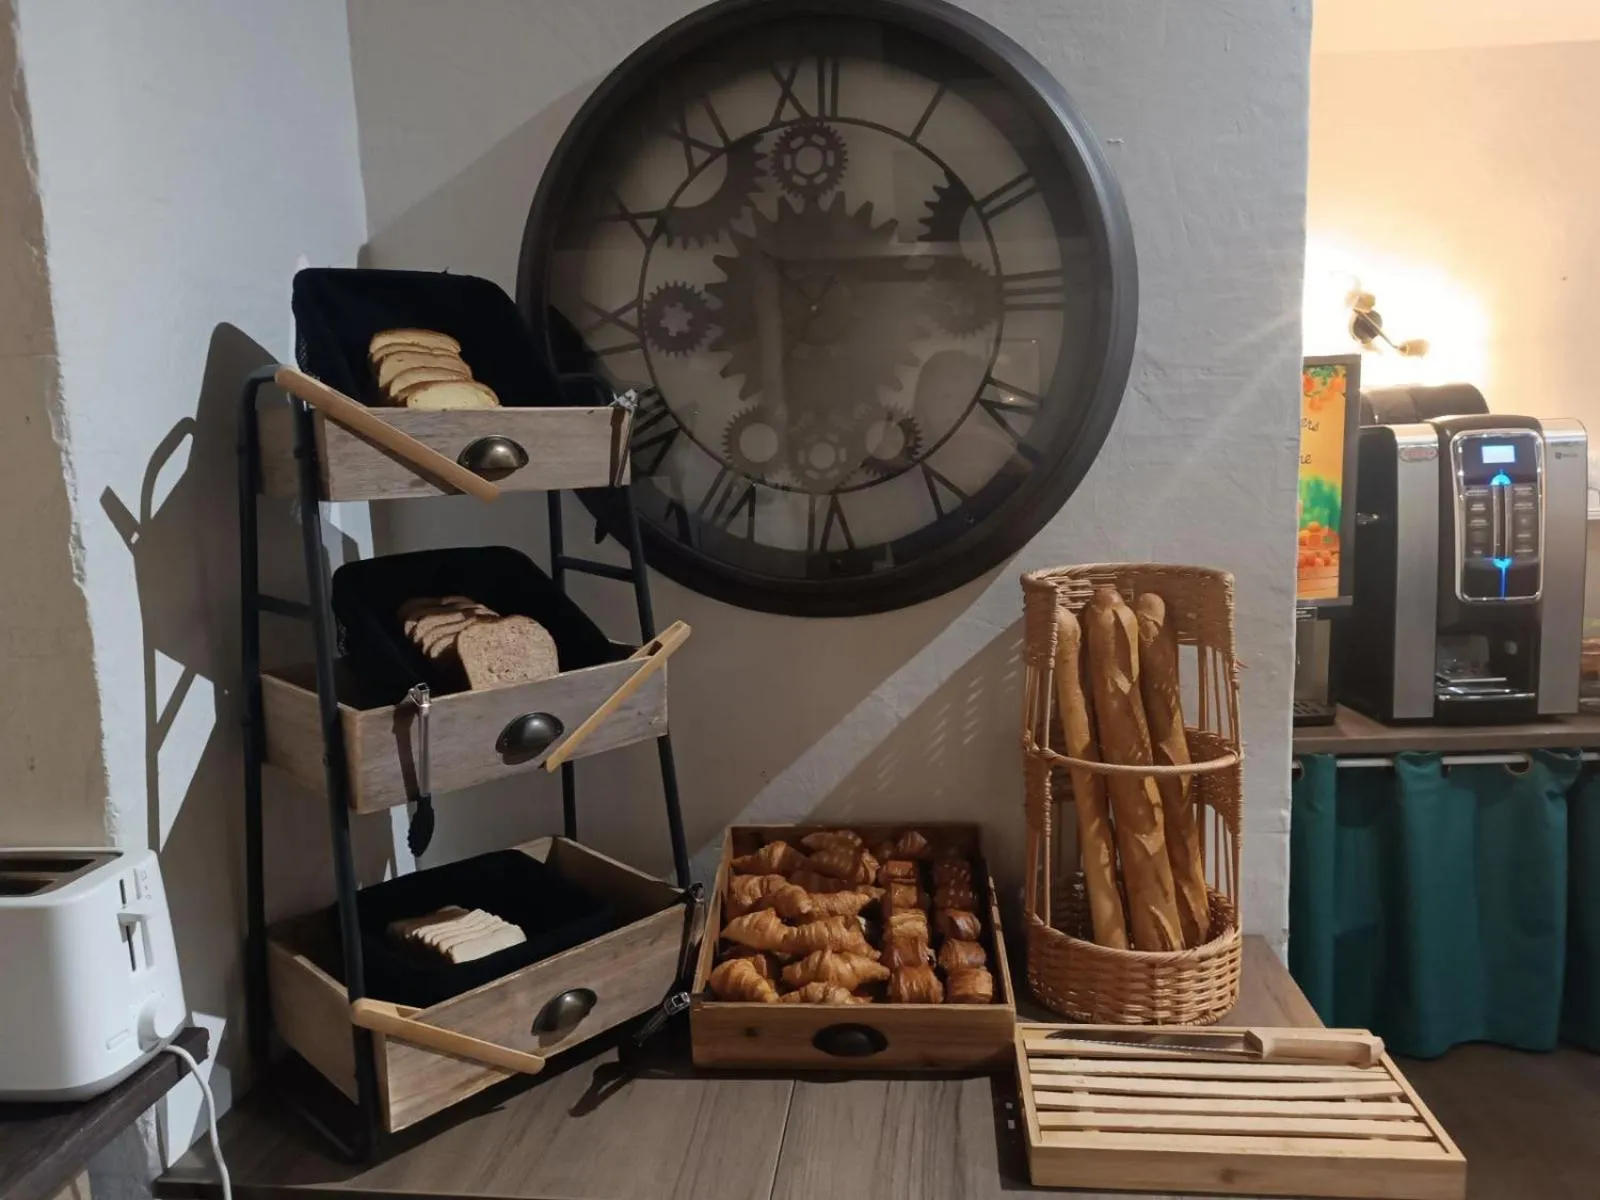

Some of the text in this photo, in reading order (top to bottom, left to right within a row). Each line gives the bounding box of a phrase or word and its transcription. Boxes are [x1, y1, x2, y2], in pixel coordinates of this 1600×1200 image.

[771, 56, 839, 124] XII
[978, 173, 1037, 220] II
[1001, 269, 1065, 310] III
[921, 461, 974, 520] V
